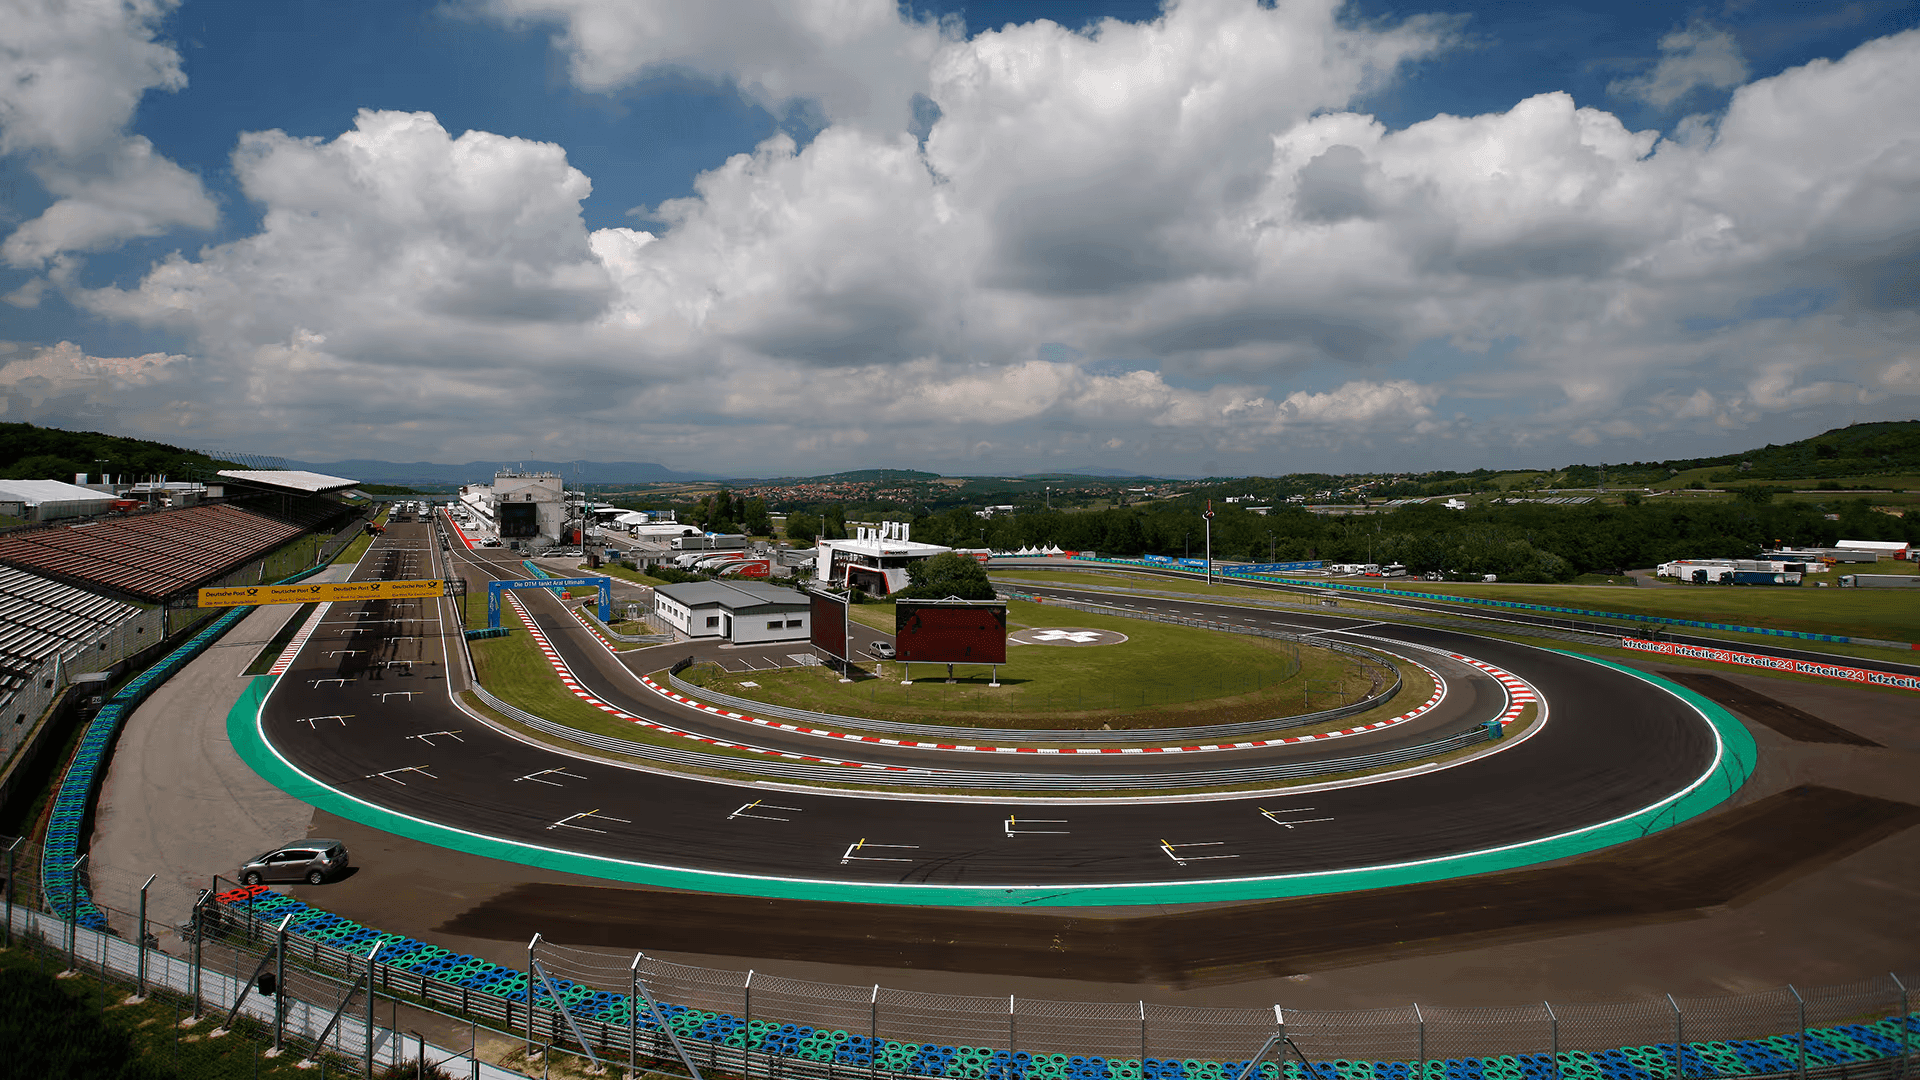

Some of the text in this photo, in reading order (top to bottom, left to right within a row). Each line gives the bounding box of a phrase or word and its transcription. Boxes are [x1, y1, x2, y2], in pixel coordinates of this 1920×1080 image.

[1623, 638, 1673, 654] kfzteile24
[1675, 646, 1730, 661] kfzteile24
[1732, 654, 1793, 671] kfzteile24
[1796, 662, 1864, 681] kfzteile24
